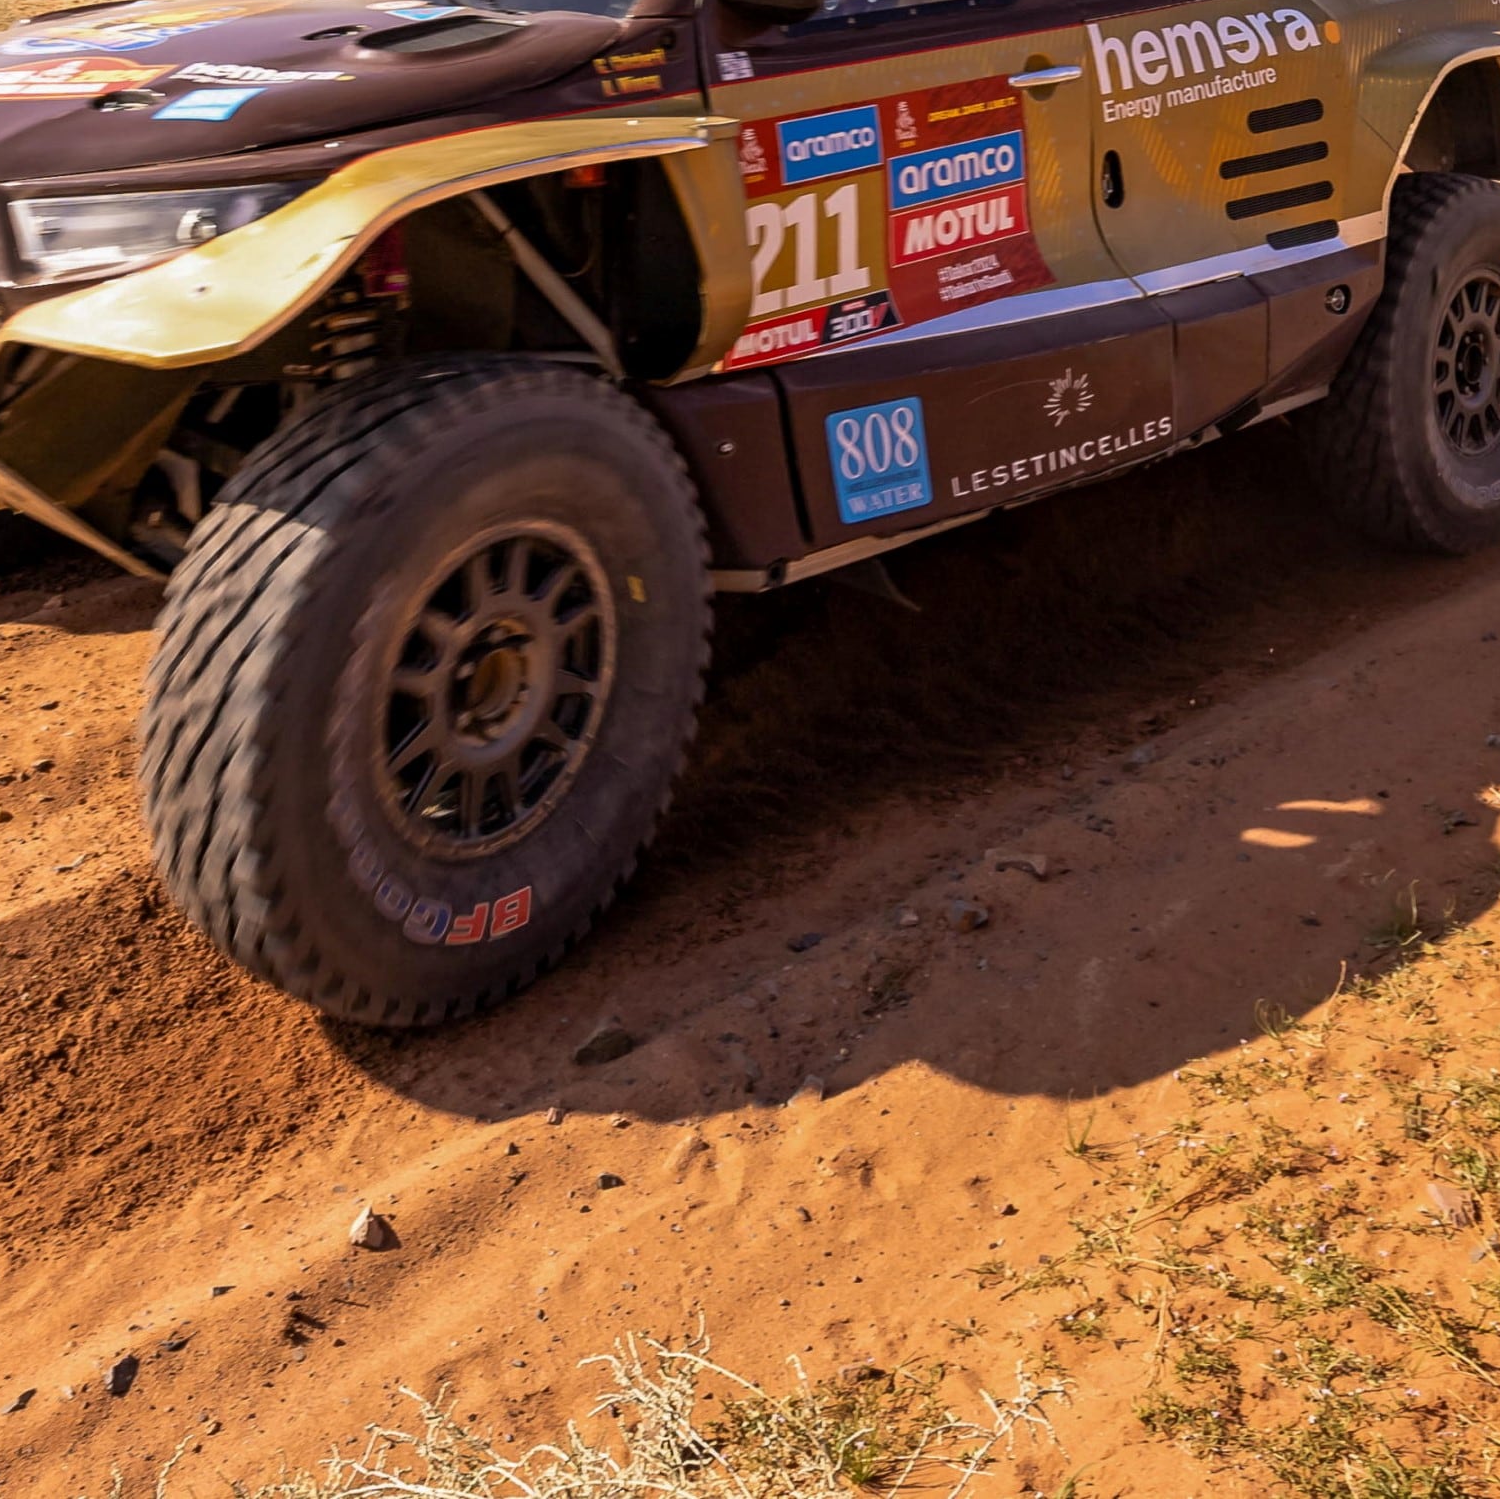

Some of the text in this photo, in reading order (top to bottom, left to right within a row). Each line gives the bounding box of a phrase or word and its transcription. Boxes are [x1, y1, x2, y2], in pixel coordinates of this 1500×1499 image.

[1087, 8, 1321, 95] hemera
[1102, 67, 1277, 123] Energy manufacture
[786, 126, 876, 162] aramco
[900, 144, 1015, 195] aramco
[744, 183, 871, 318] 211
[903, 195, 1015, 256] MOTUL
[733, 318, 819, 358] MOTUL
[835, 406, 920, 480] 808
[950, 416, 1173, 498] LESETINCELLES
[848, 482, 925, 514] WATER
